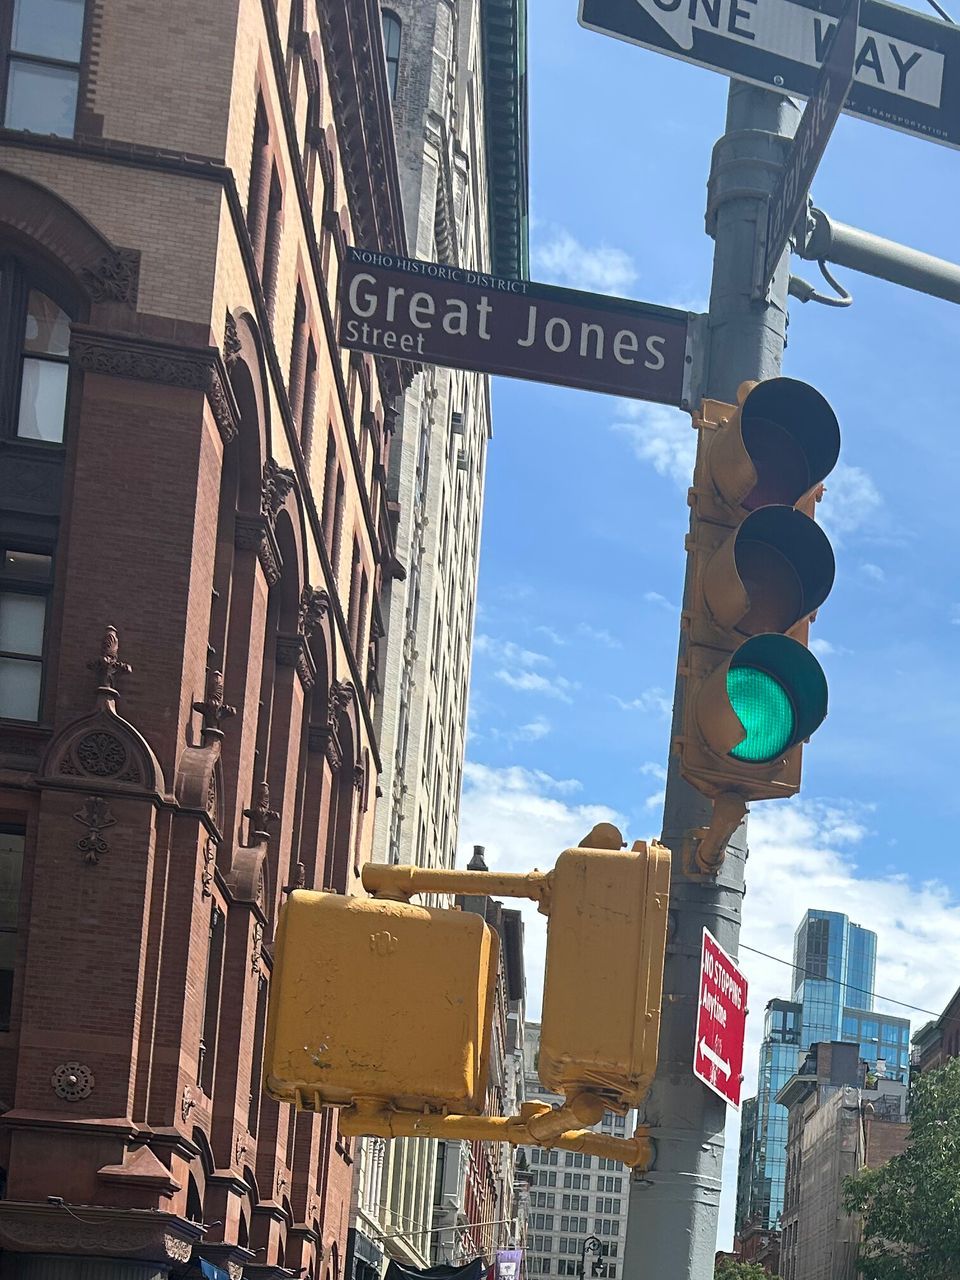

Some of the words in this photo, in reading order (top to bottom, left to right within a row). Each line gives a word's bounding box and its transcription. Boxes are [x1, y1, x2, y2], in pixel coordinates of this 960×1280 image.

[653, 0, 756, 41] NE
[352, 249, 393, 267] NOHO
[396, 258, 462, 282] HISTORIC
[466, 270, 530, 294] DISTRICT
[346, 320, 425, 355] Street
[349, 272, 493, 341] Great
[517, 305, 666, 371] Jones
[704, 948, 714, 980] NO
[714, 961, 743, 1011] STOPPING
[702, 983, 728, 1029] Anytime
